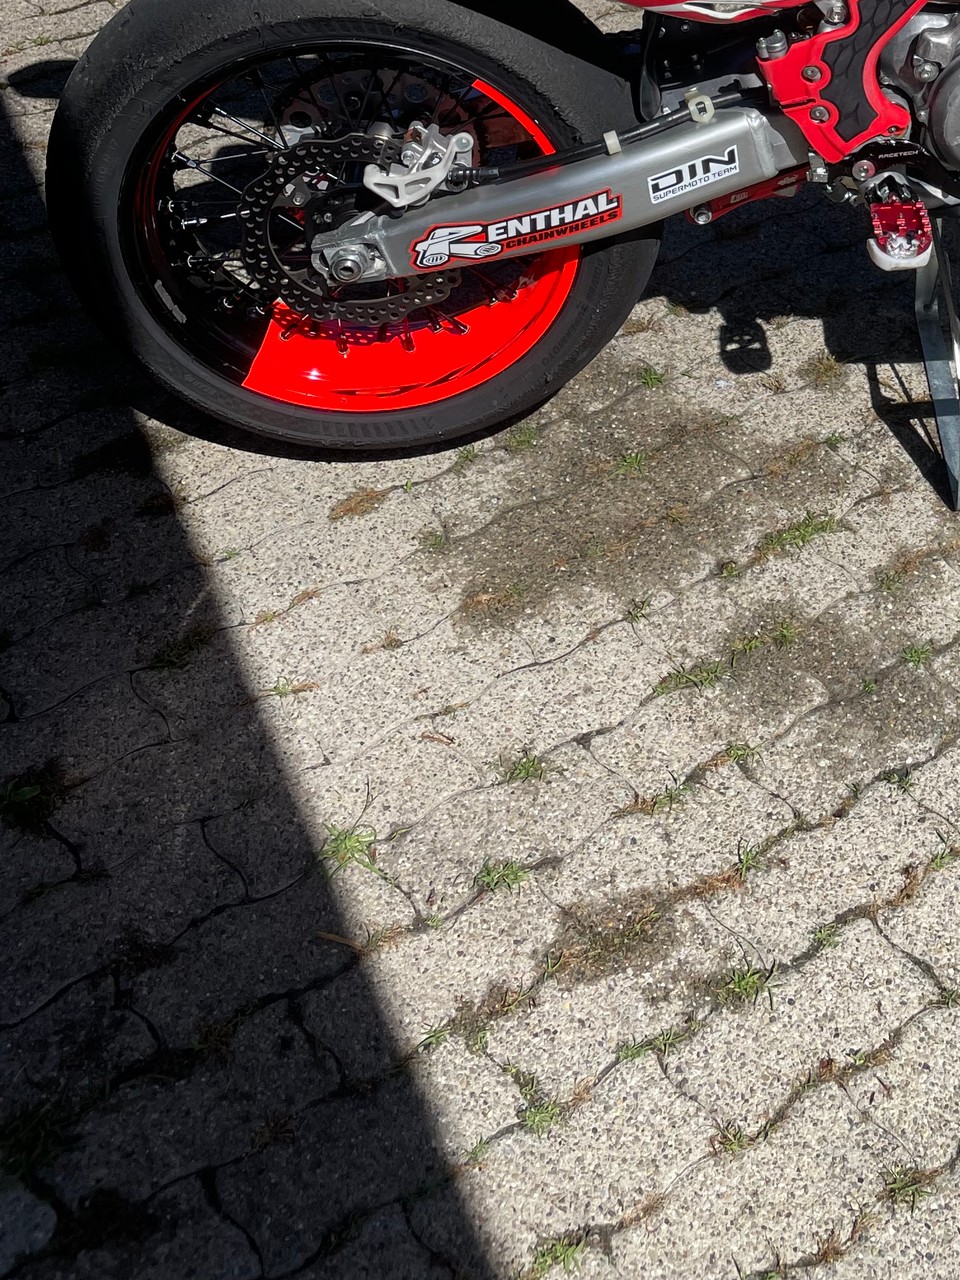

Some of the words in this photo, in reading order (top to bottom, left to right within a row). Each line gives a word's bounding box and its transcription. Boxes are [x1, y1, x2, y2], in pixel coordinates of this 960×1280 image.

[651, 148, 738, 194] DIN
[878, 149, 919, 159] RACETECH
[653, 175, 710, 202] SUPERMOTO
[711, 164, 738, 181] TEAM
[505, 211, 619, 249] CHAINWHEELS
